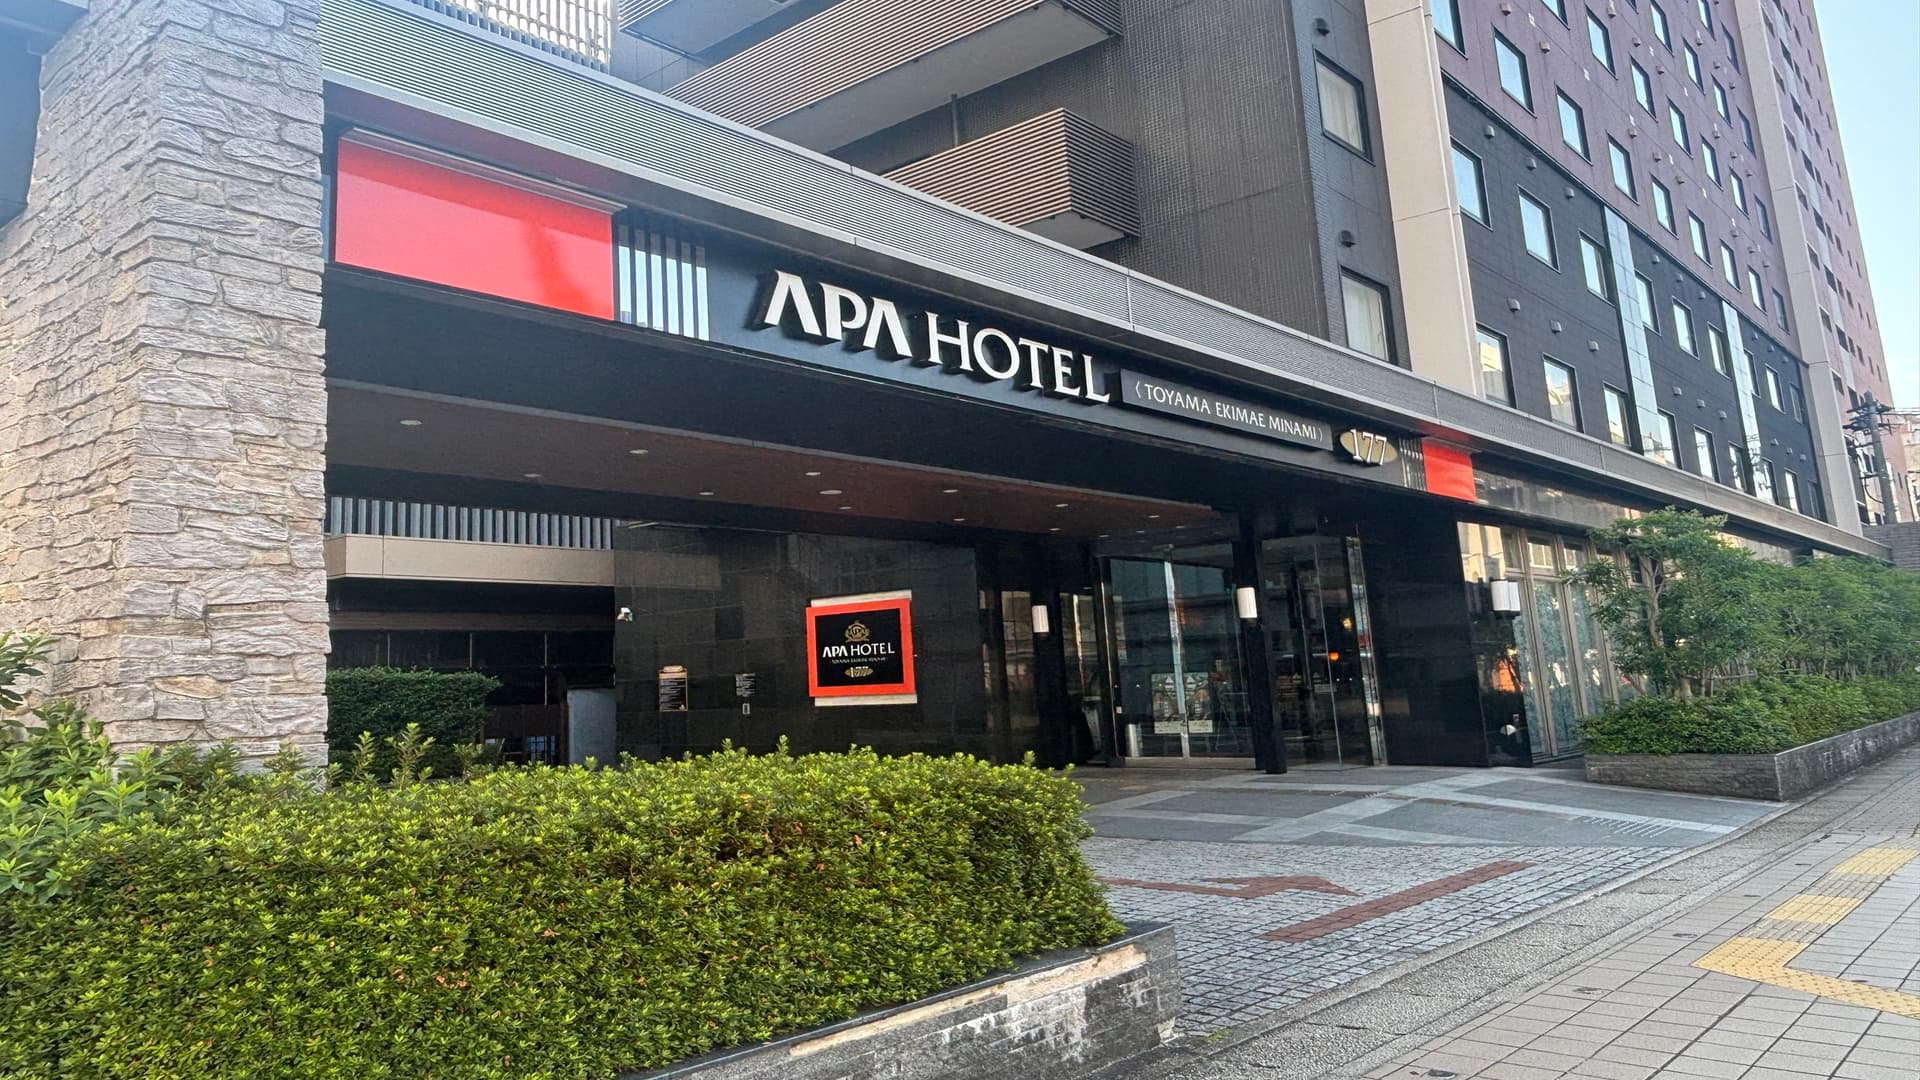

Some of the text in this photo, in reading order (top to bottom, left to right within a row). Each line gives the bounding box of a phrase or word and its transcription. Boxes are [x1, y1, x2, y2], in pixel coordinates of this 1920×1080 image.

[764, 269, 1110, 403] APA HOTEL
[1216, 401, 1266, 428] EKIMAE
[1351, 428, 1387, 466] 177
[822, 642, 896, 658] APA HOTEL
